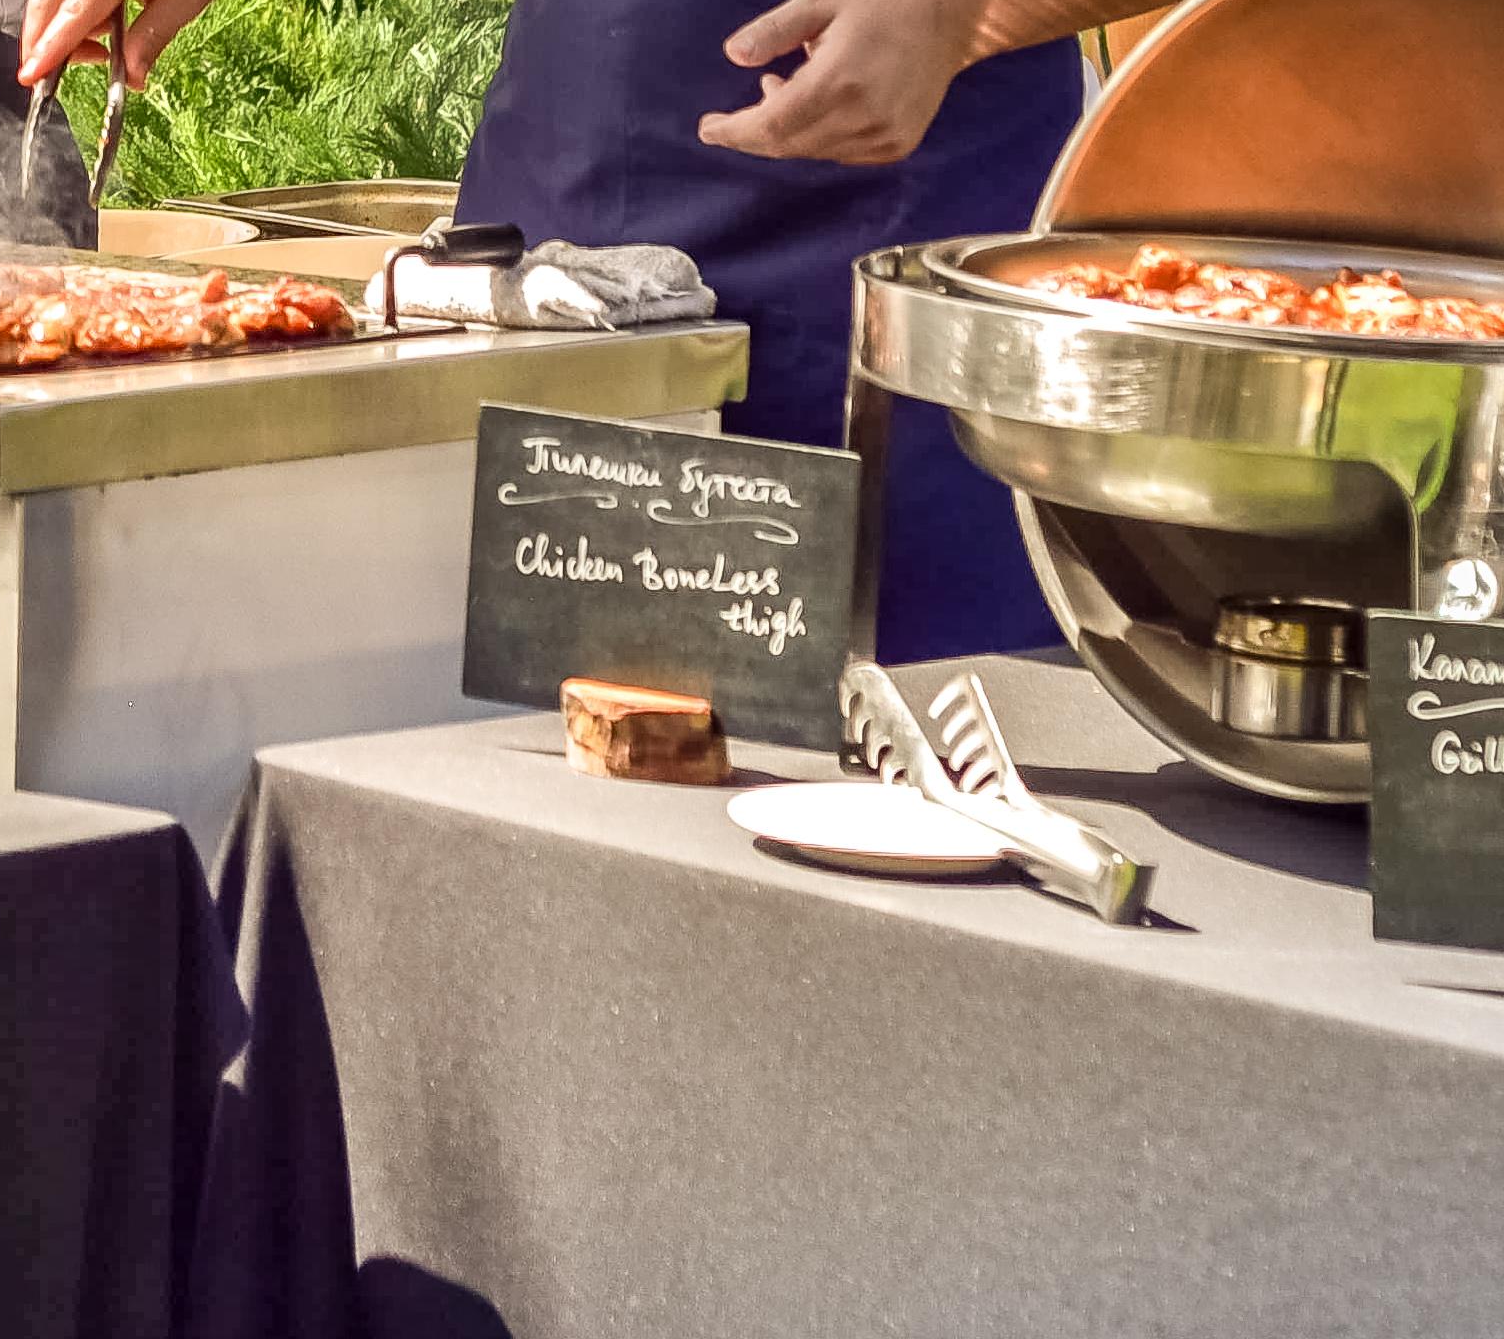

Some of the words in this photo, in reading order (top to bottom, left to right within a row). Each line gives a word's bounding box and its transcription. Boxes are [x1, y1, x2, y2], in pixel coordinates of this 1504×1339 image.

[521, 436, 664, 489] Пилешки
[514, 532, 624, 584] Chicken
[718, 596, 808, 657] thigh
